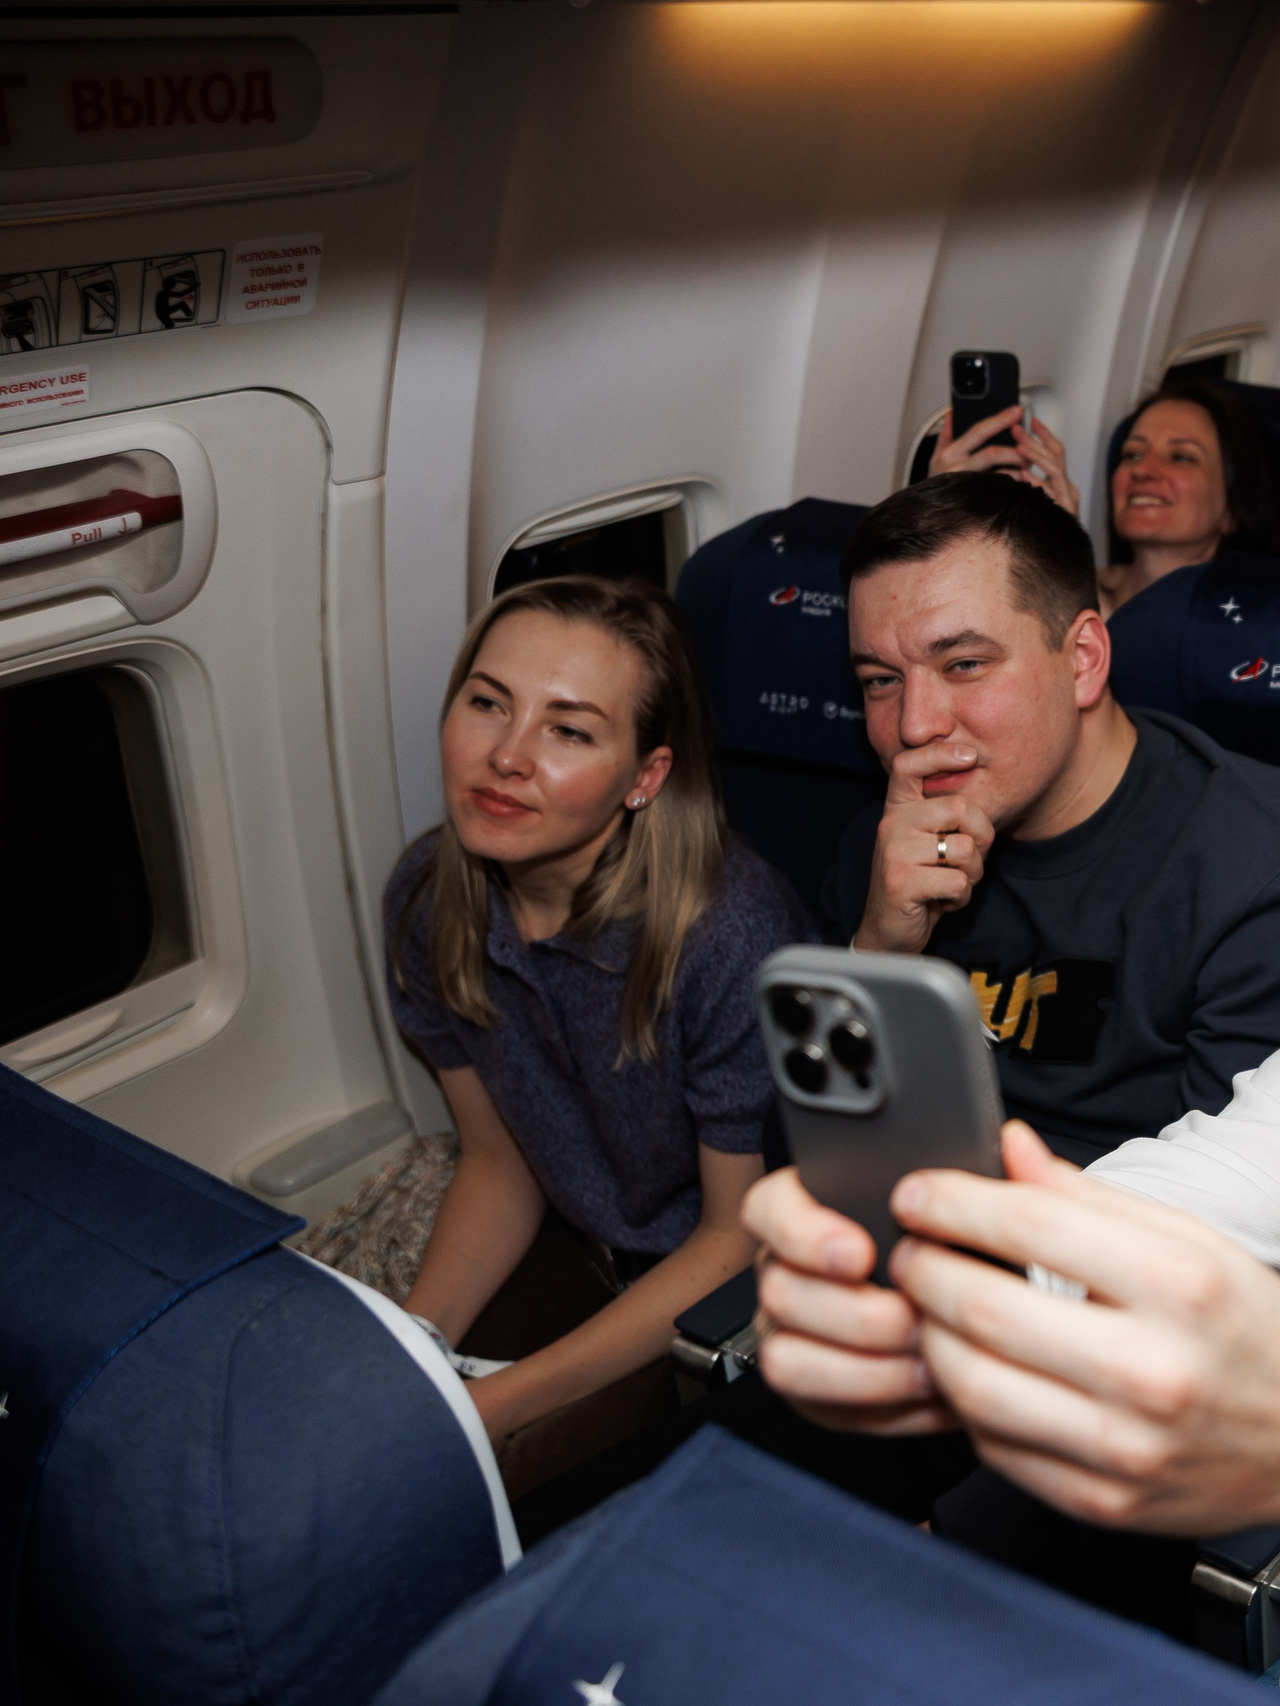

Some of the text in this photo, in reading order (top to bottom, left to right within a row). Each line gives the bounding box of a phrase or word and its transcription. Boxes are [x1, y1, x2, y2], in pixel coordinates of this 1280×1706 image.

[71, 70, 275, 132] ВЫХОД
[250, 264, 304, 277] ТОЛЬКО В
[60, 373, 87, 385] USE
[71, 527, 102, 545] Pull
